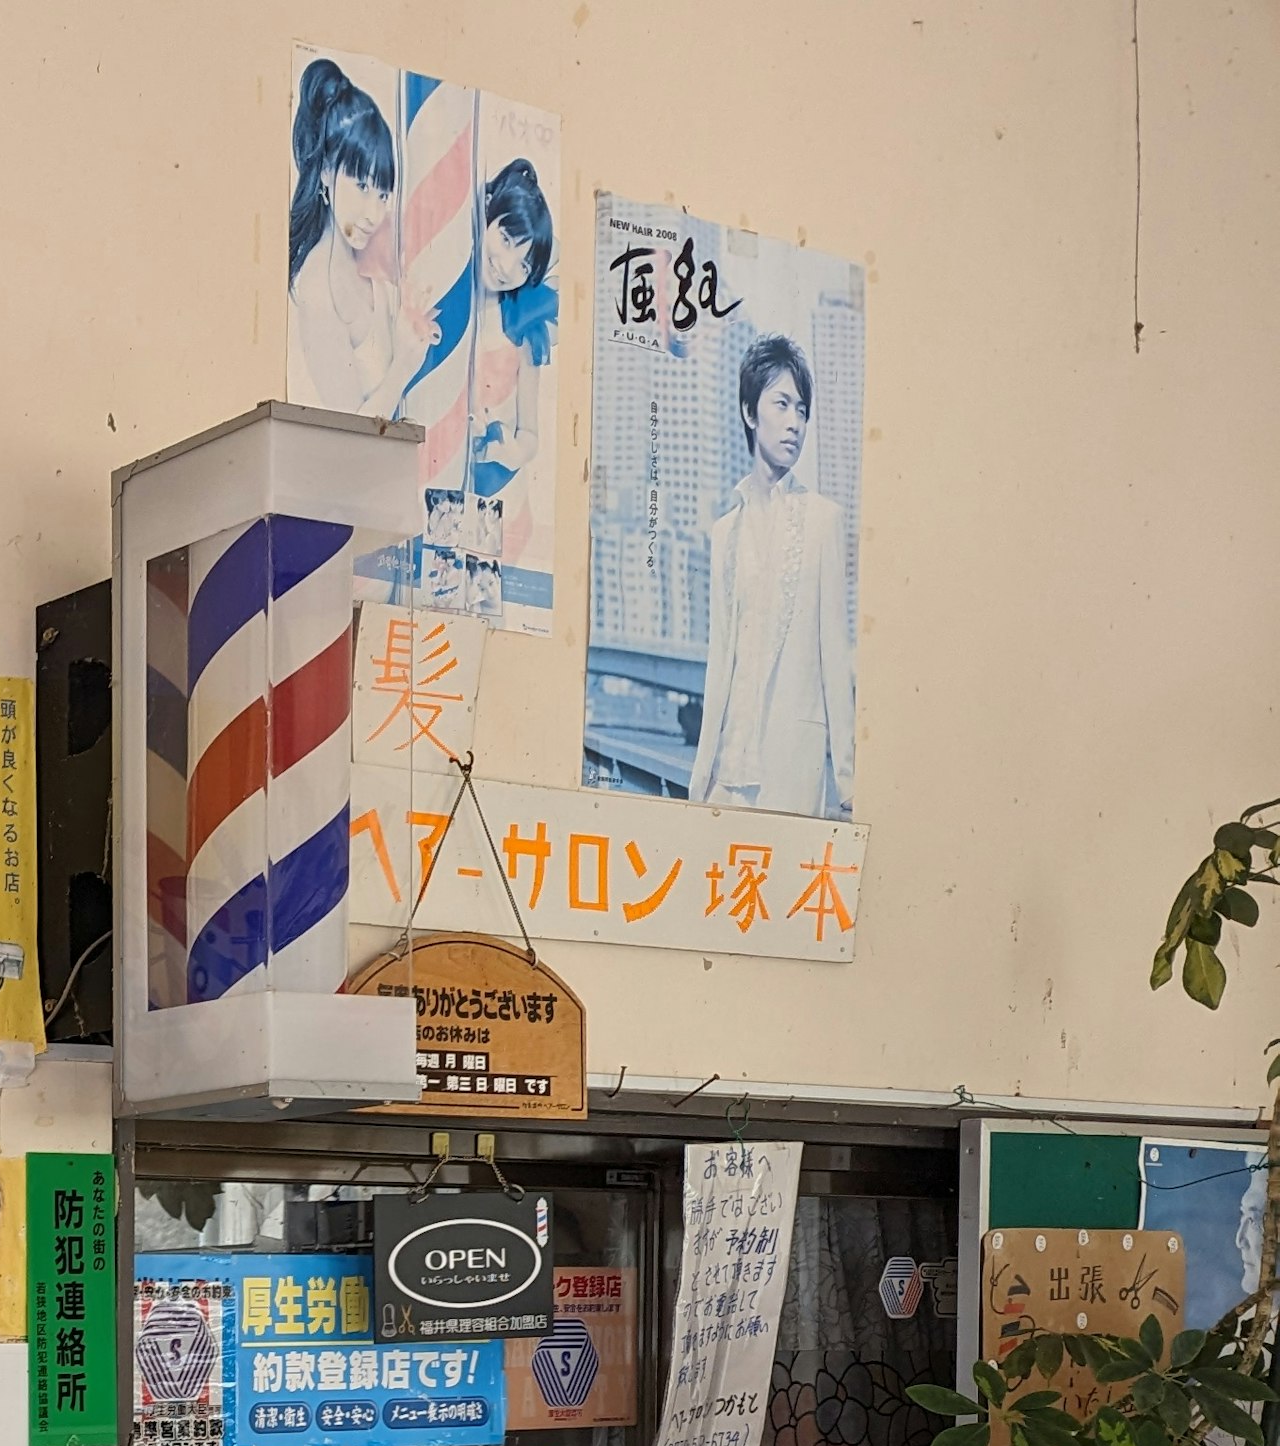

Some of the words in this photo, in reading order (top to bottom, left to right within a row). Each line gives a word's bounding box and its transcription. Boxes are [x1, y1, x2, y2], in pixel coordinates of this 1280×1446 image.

[610, 217, 630, 231] NEW
[631, 222, 653, 237] HAIR
[656, 228, 678, 242] 2008
[366, 619, 465, 762] 髪
[444, 1053, 458, 1070] 月
[462, 1054, 487, 1071] 曜日
[476, 1077, 488, 1092] 日
[493, 1077, 518, 1094] 曜日
[524, 1078, 550, 1095] です
[703, 1150, 772, 1181] お客様へ
[92, 1170, 106, 1272] あなたの街の
[423, 1246, 507, 1271] OPEN
[420, 1272, 511, 1287] いらっしゃいませ
[1049, 1265, 1107, 1305] 出張
[54, 1189, 87, 1412] 防犯連絡所
[419, 1312, 548, 1337] 福井県理容組合加盟店
[252, 1350, 479, 1394] 約款登録店です!
[253, 1404, 307, 1429] 清潔・衛生
[319, 1404, 376, 1428] 安全・安心
